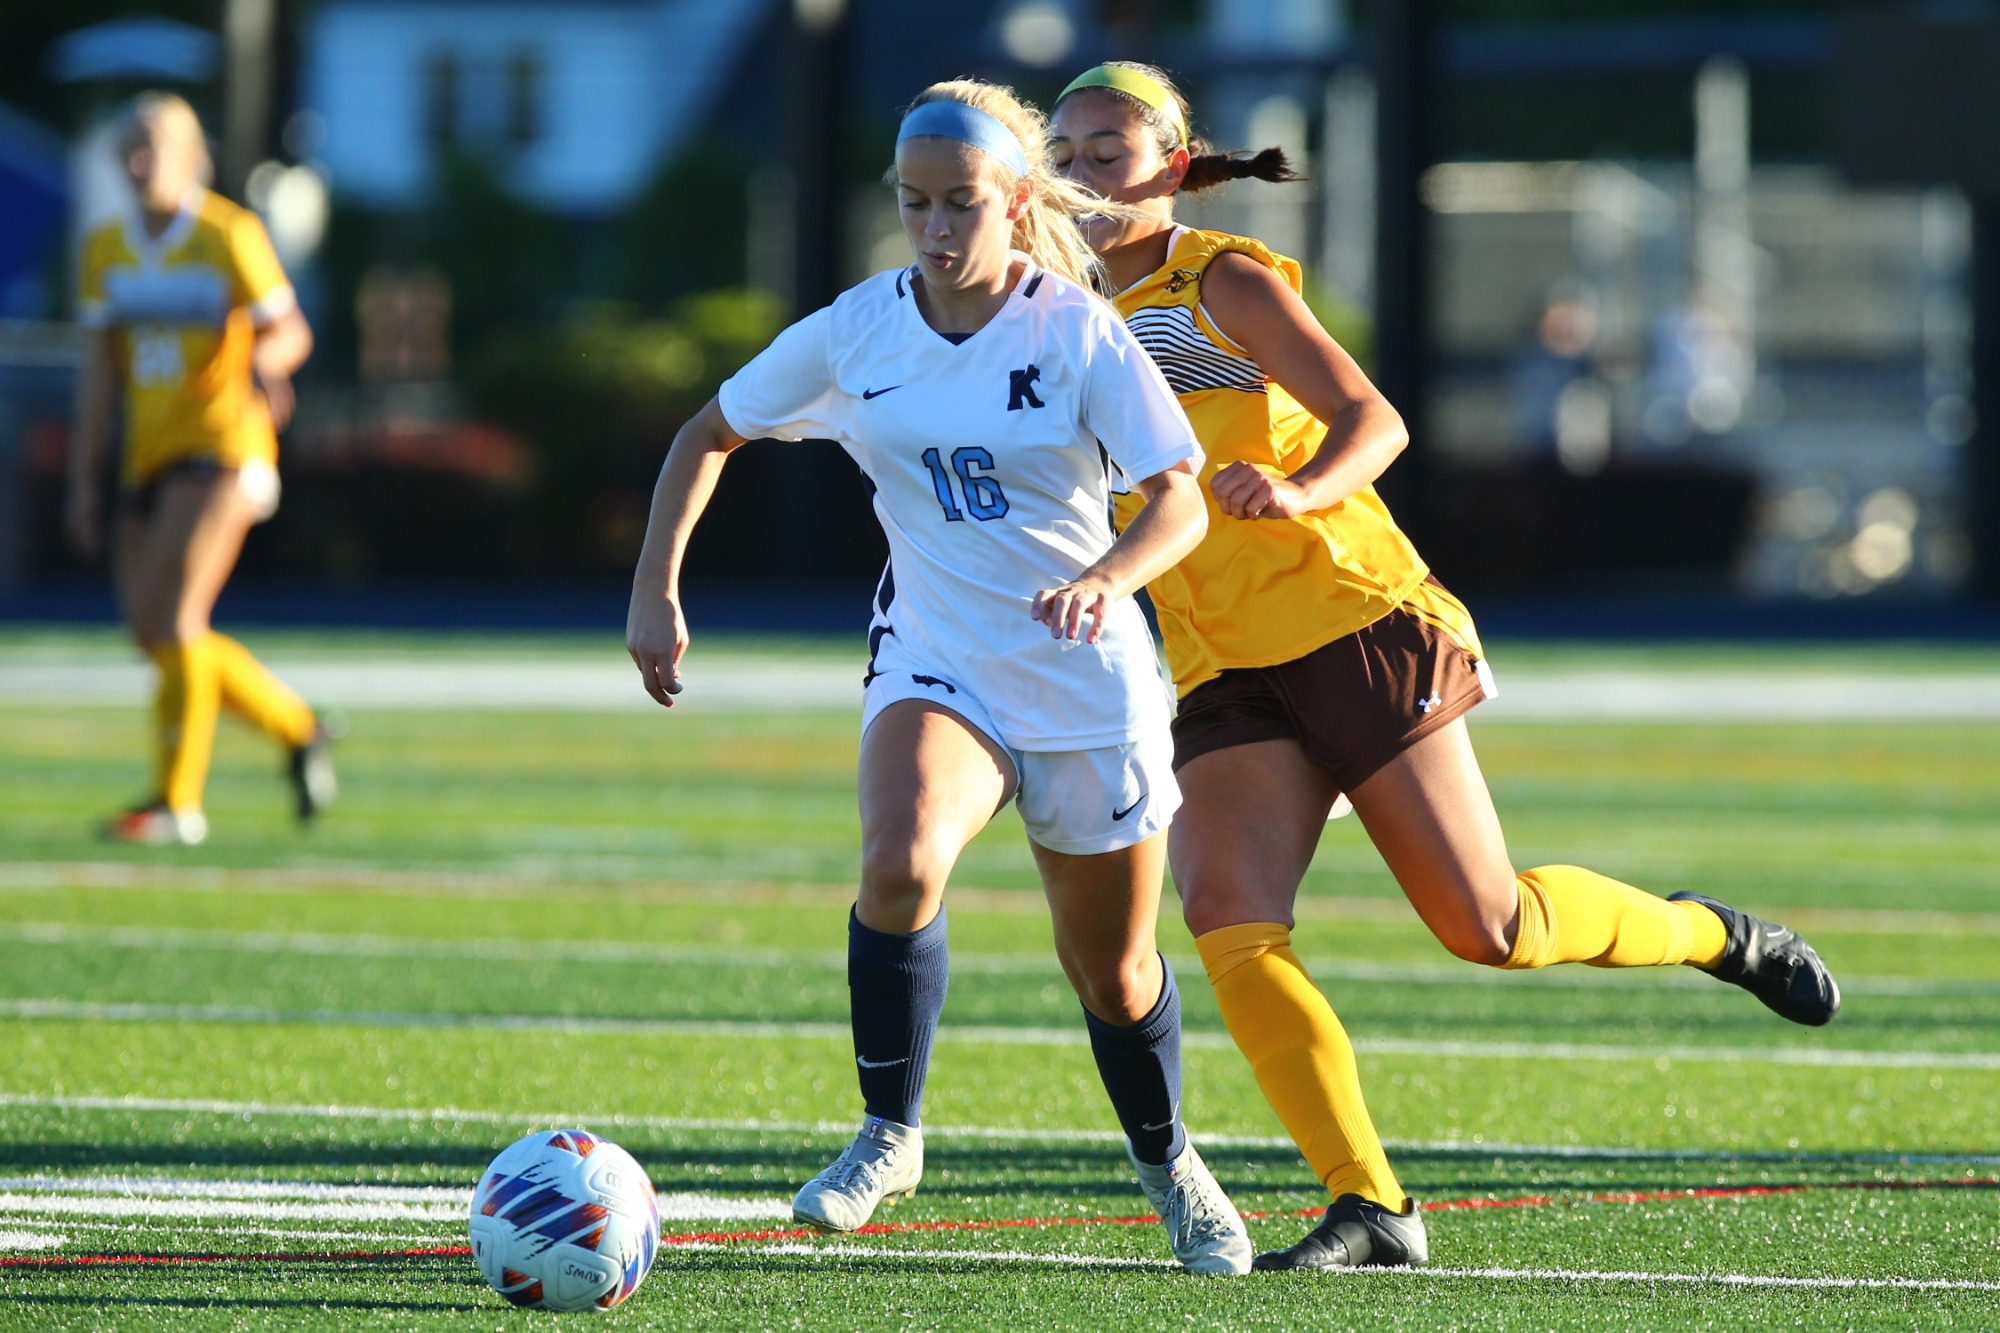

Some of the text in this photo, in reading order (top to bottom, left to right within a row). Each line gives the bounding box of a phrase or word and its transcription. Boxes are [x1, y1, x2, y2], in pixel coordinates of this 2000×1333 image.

[1007, 363, 1045, 411] K
[921, 446, 1010, 522] 16
[565, 1264, 600, 1284] KUWS
